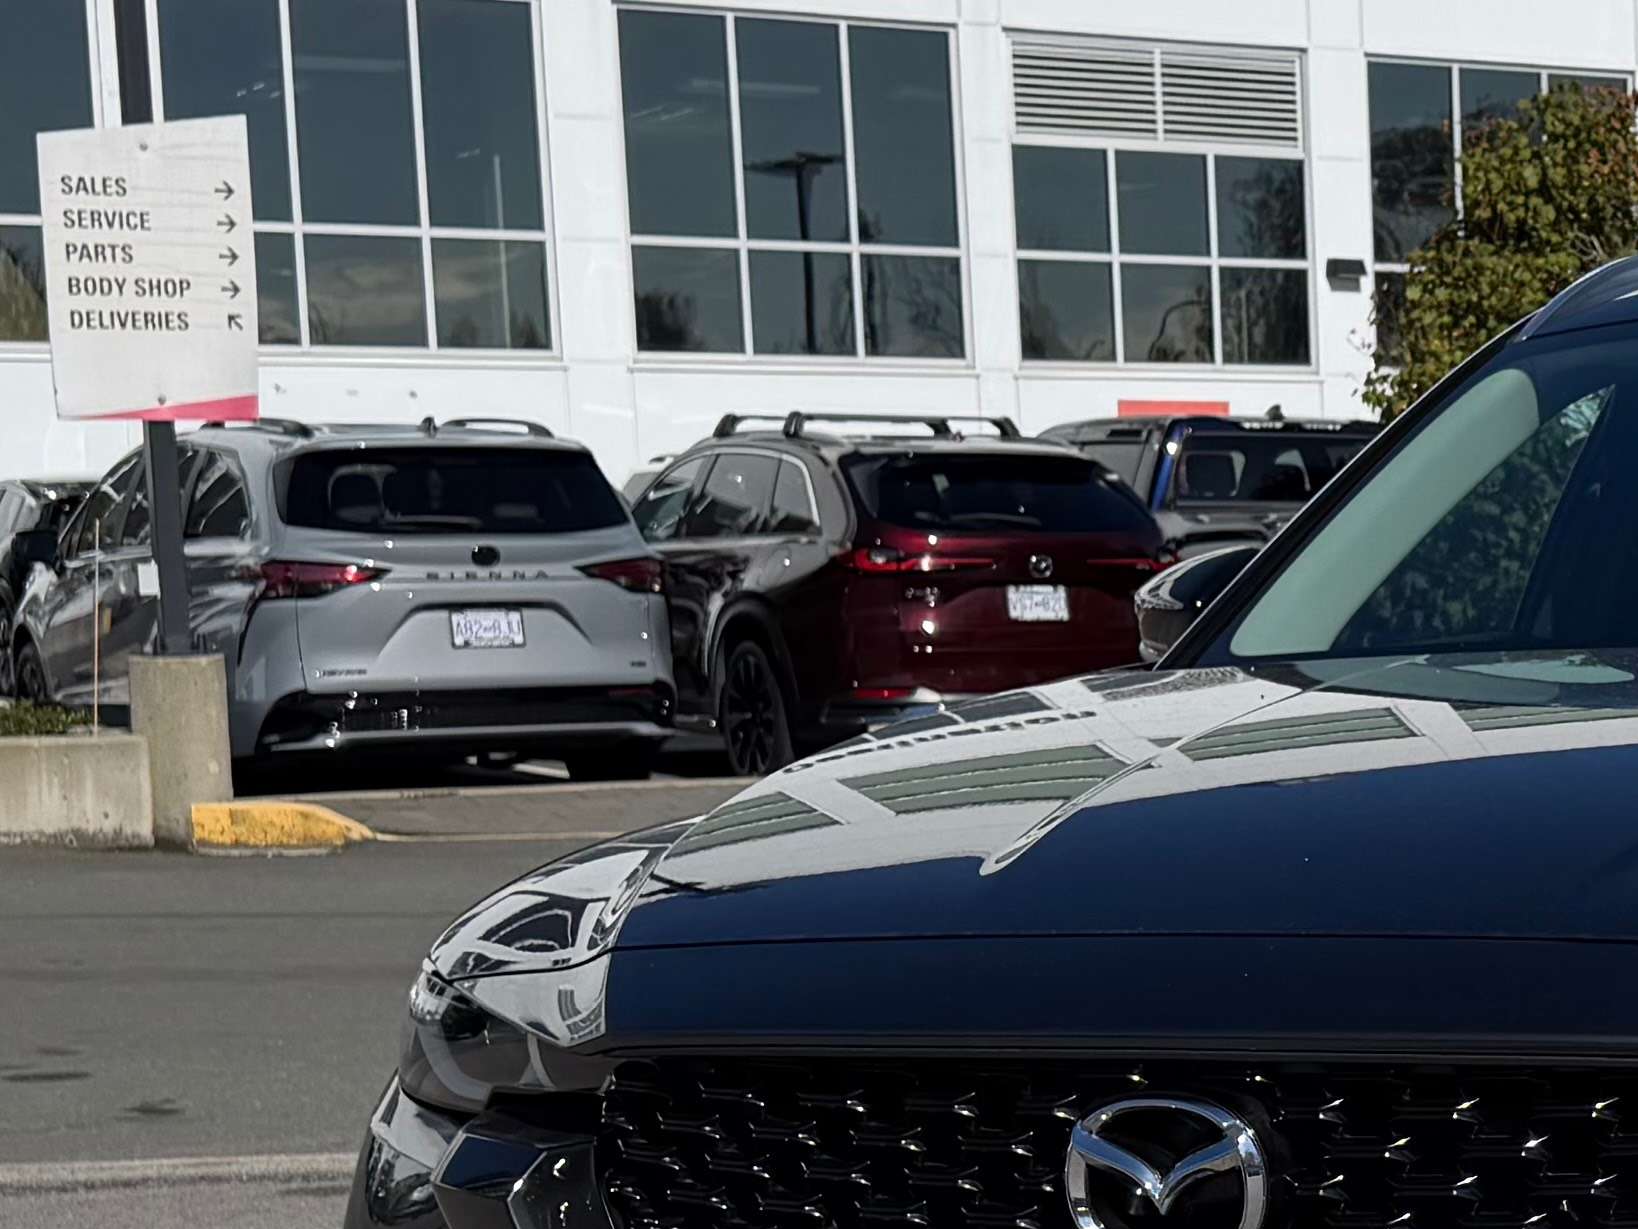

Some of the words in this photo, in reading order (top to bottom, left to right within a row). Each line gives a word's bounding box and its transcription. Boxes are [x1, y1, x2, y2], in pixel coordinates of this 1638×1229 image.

[60, 175, 127, 198] SALES
[63, 209, 152, 232] SERVICE
[65, 242, 134, 265] PARTS
[67, 276, 127, 297] BODY
[134, 276, 191, 300] SHOP
[70, 309, 190, 332] DELIVERIES
